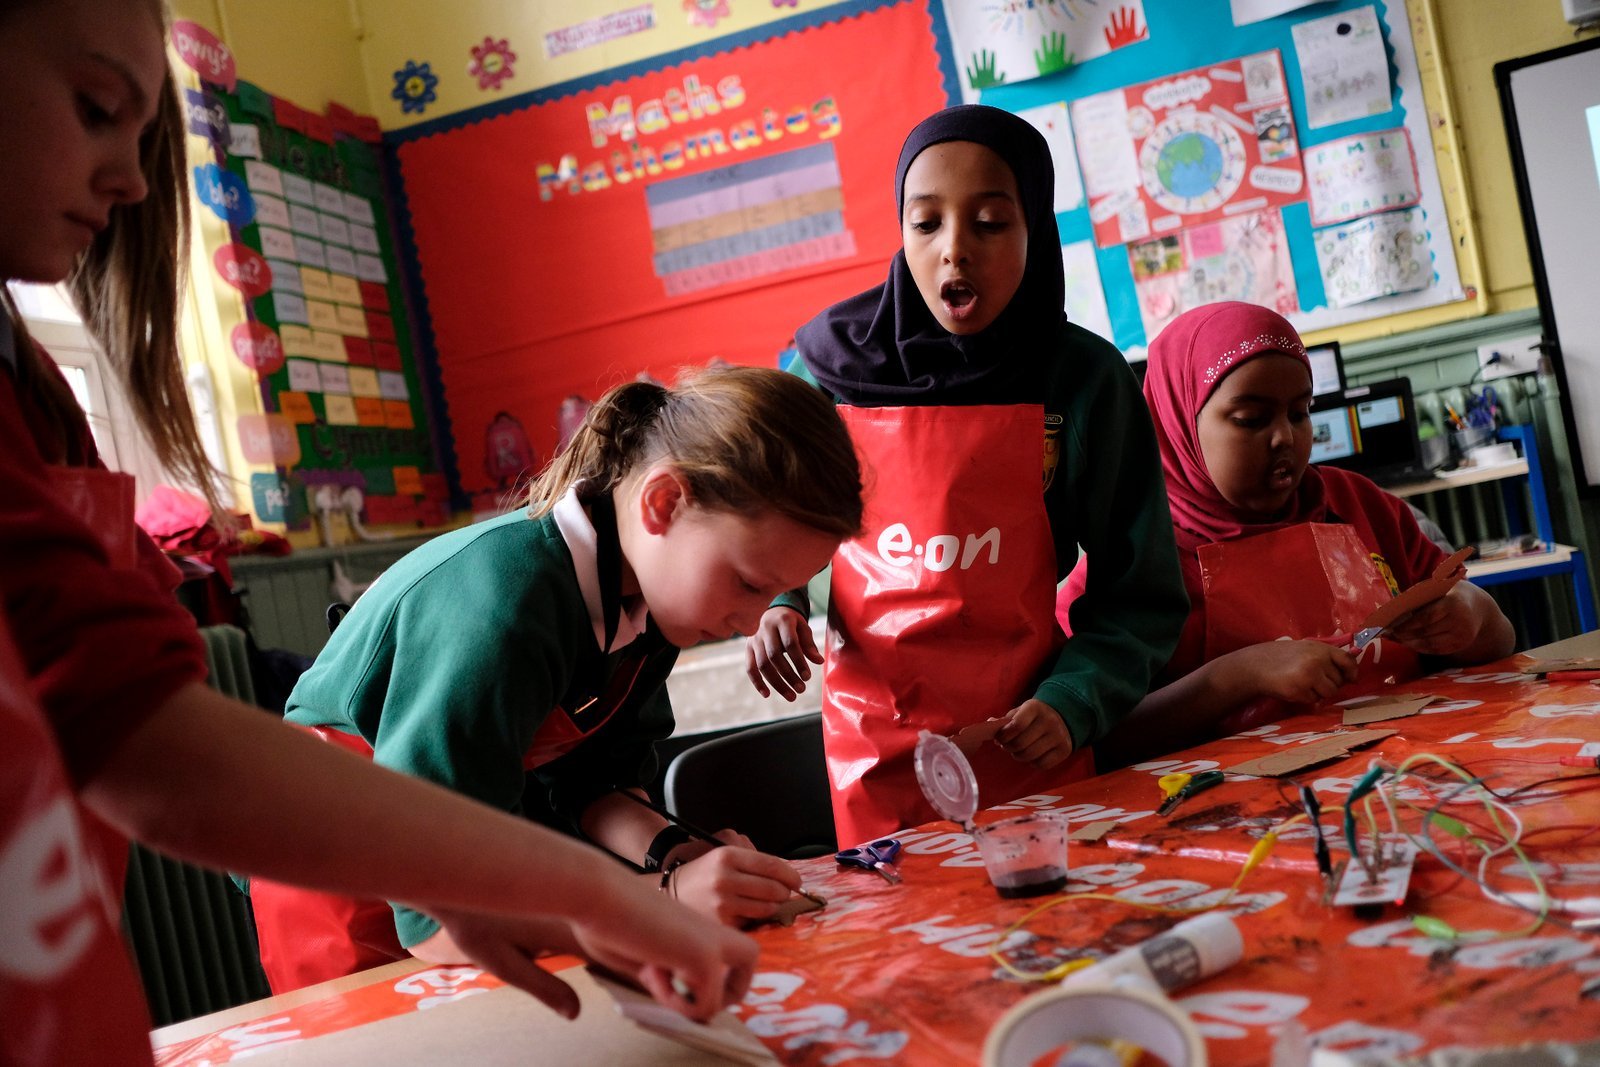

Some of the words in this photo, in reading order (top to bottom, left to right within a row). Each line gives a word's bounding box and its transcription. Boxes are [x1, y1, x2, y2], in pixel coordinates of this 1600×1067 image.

[177, 31, 228, 75] pwy?
[585, 74, 746, 147] Maths
[535, 97, 842, 202] Mathemateg
